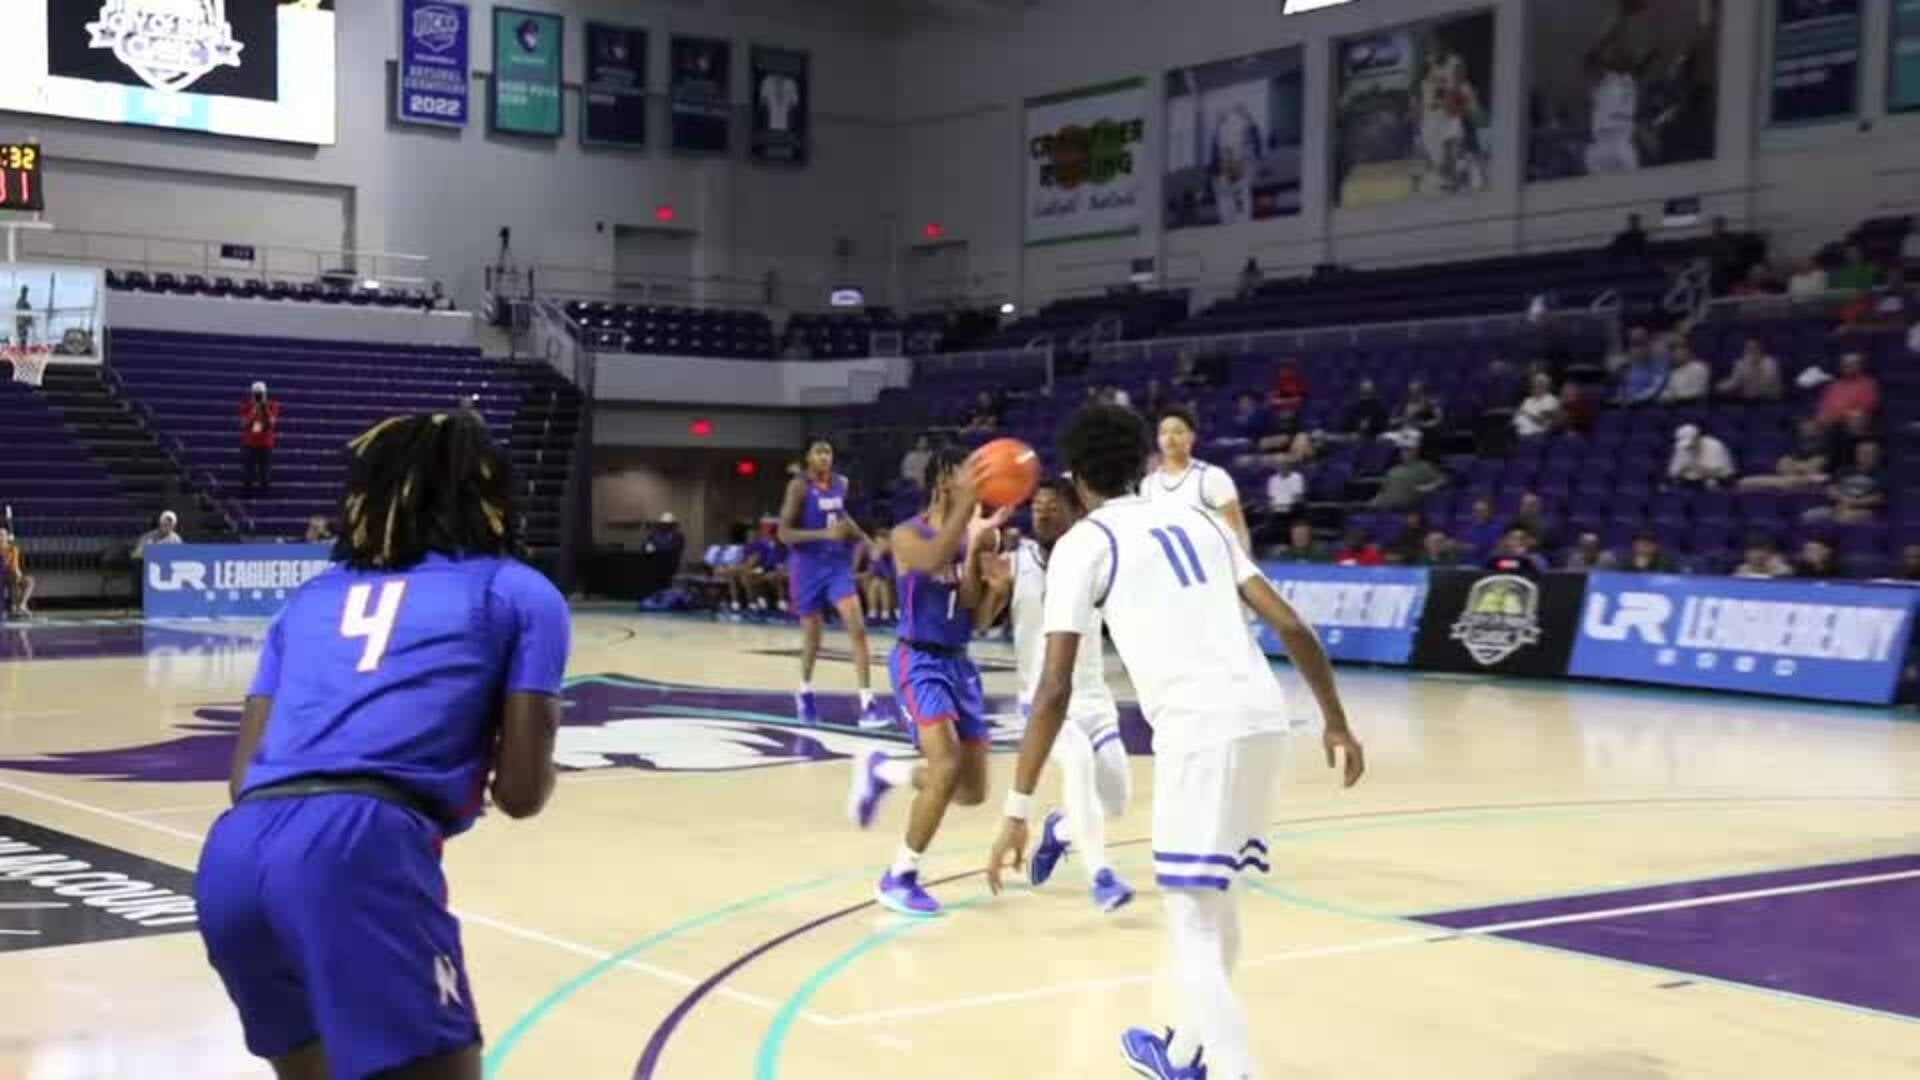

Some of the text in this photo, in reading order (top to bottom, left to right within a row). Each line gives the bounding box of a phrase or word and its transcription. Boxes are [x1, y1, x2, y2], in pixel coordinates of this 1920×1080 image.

[409, 94, 461, 117] 2022
[1147, 524, 1209, 588] 11
[340, 579, 406, 672] 4
